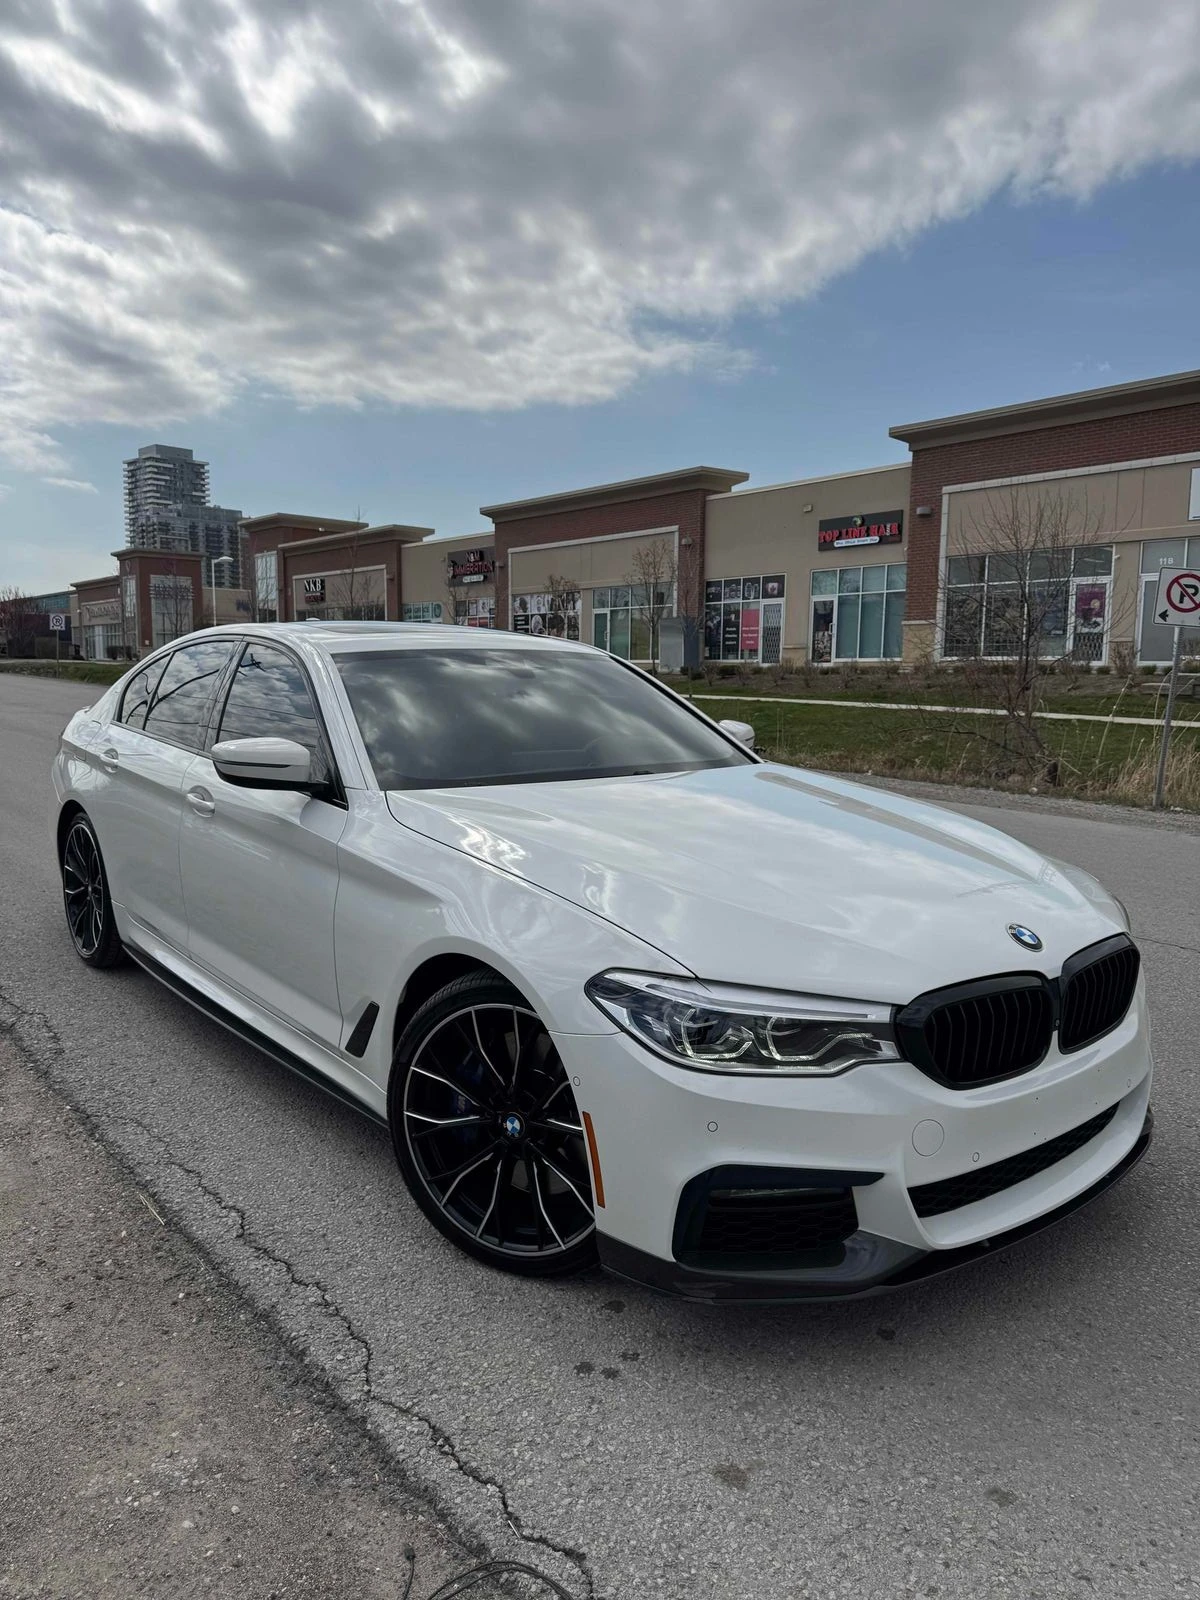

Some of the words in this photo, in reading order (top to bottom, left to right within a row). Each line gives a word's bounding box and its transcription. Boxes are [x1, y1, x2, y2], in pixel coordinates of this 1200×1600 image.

[818, 530, 839, 543] TOP
[842, 526, 867, 539] LINE
[1160, 557, 1174, 565] 118
